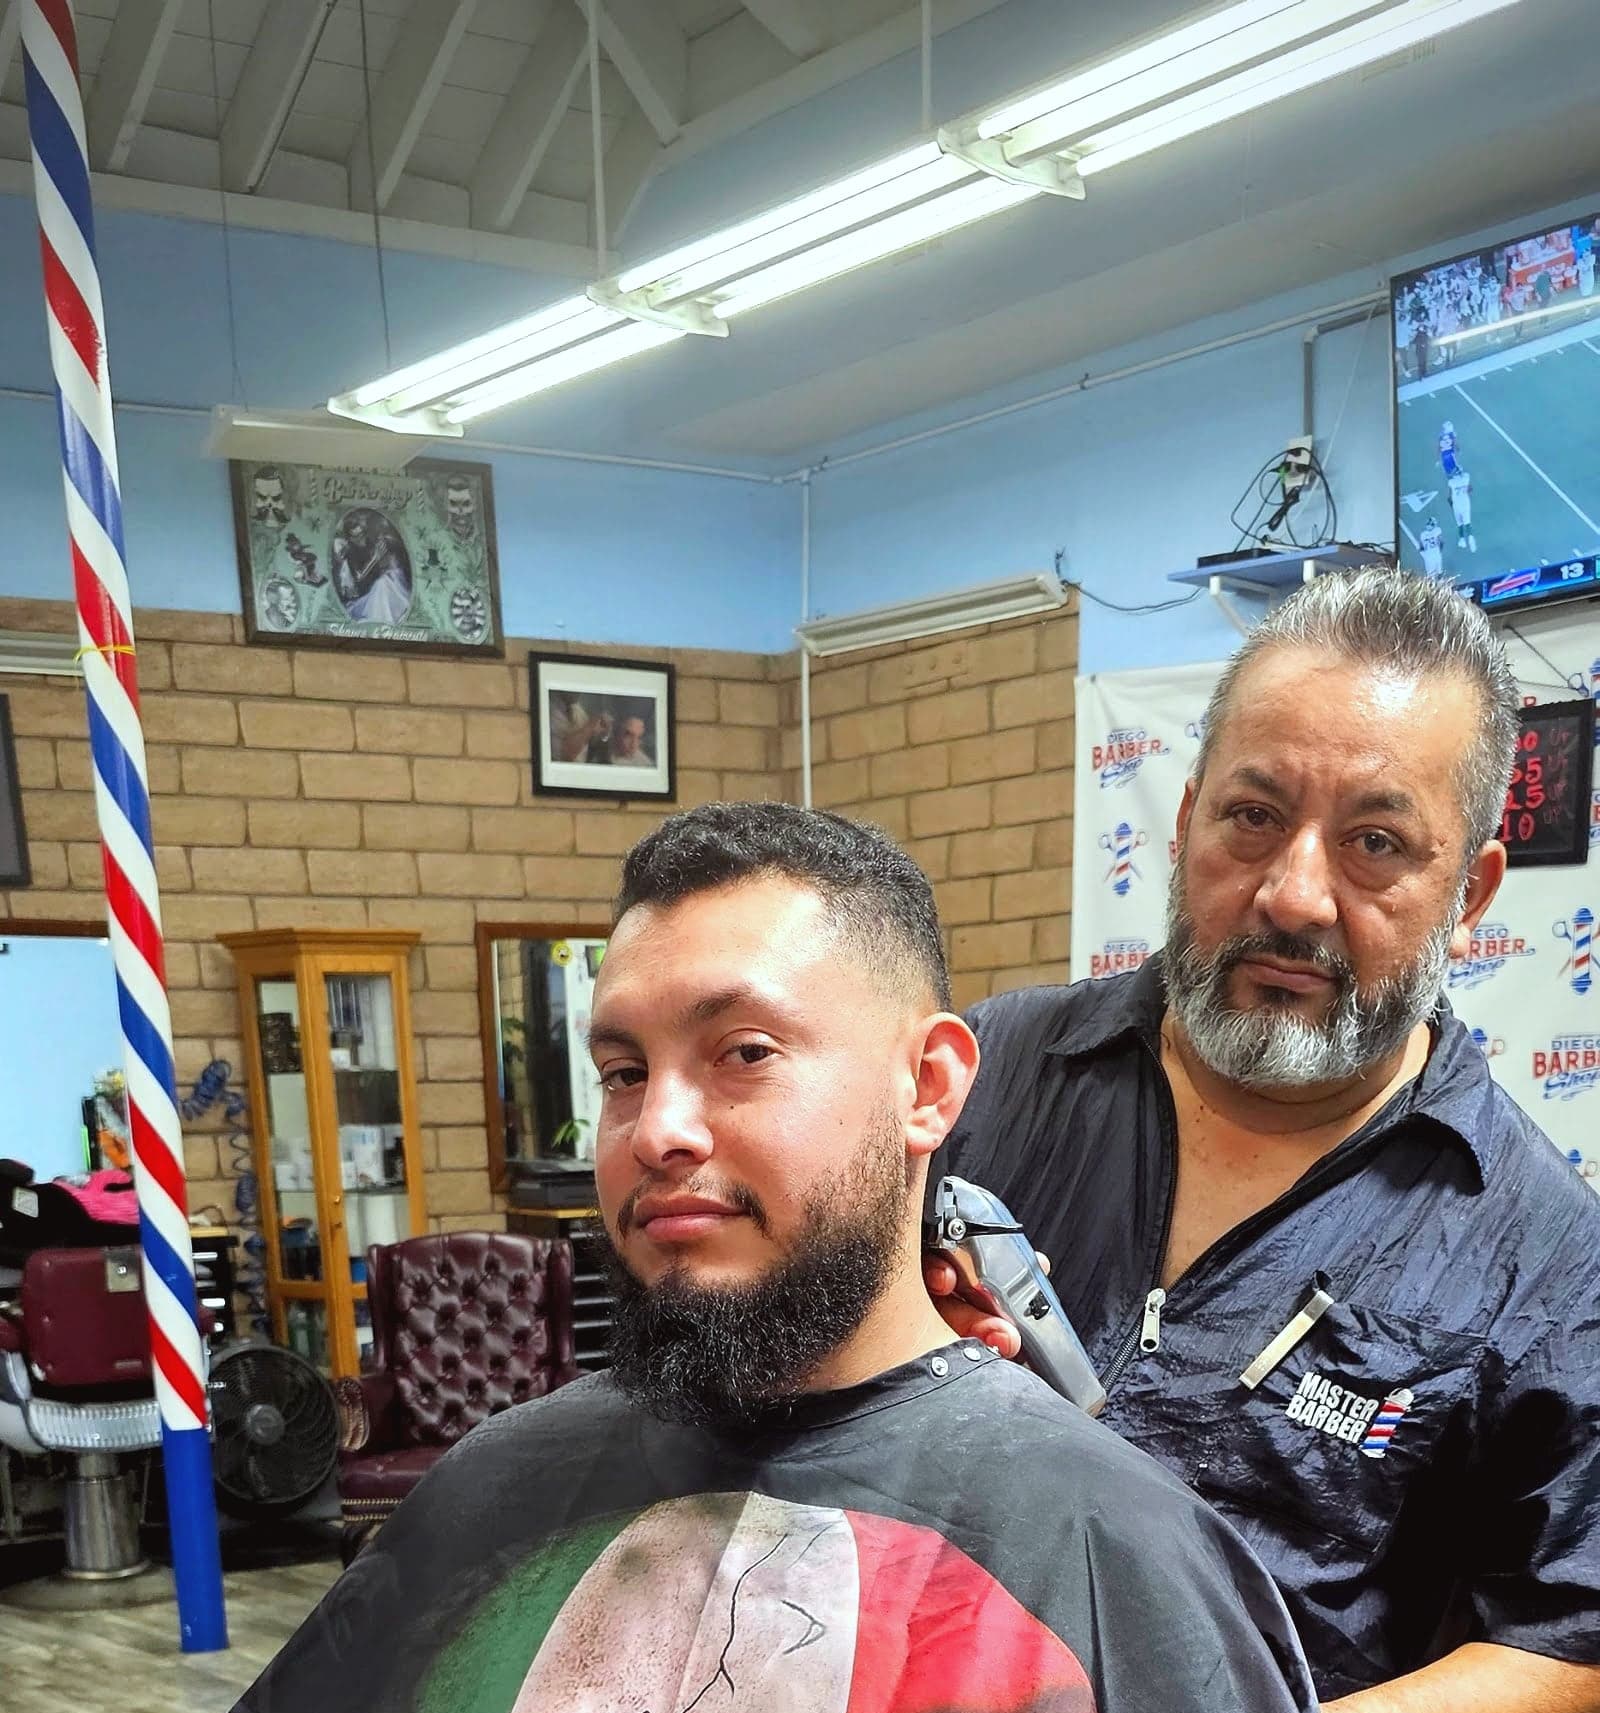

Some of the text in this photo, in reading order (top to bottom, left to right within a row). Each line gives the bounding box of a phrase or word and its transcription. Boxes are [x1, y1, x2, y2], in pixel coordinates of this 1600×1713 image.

[1560, 562, 1585, 580] 13
[1107, 730, 1146, 744] DIEGO
[1514, 730, 1539, 752] 0
[1092, 739, 1161, 771] BARBER
[1499, 812, 1535, 842] 10
[1474, 928, 1508, 939] EGO
[1104, 942, 1149, 953] DIEGO
[1466, 938, 1525, 960] RBER
[1533, 1050, 1600, 1079] BARB
[1296, 1371, 1379, 1422] MASTER
[1285, 1394, 1367, 1444] BARBER
